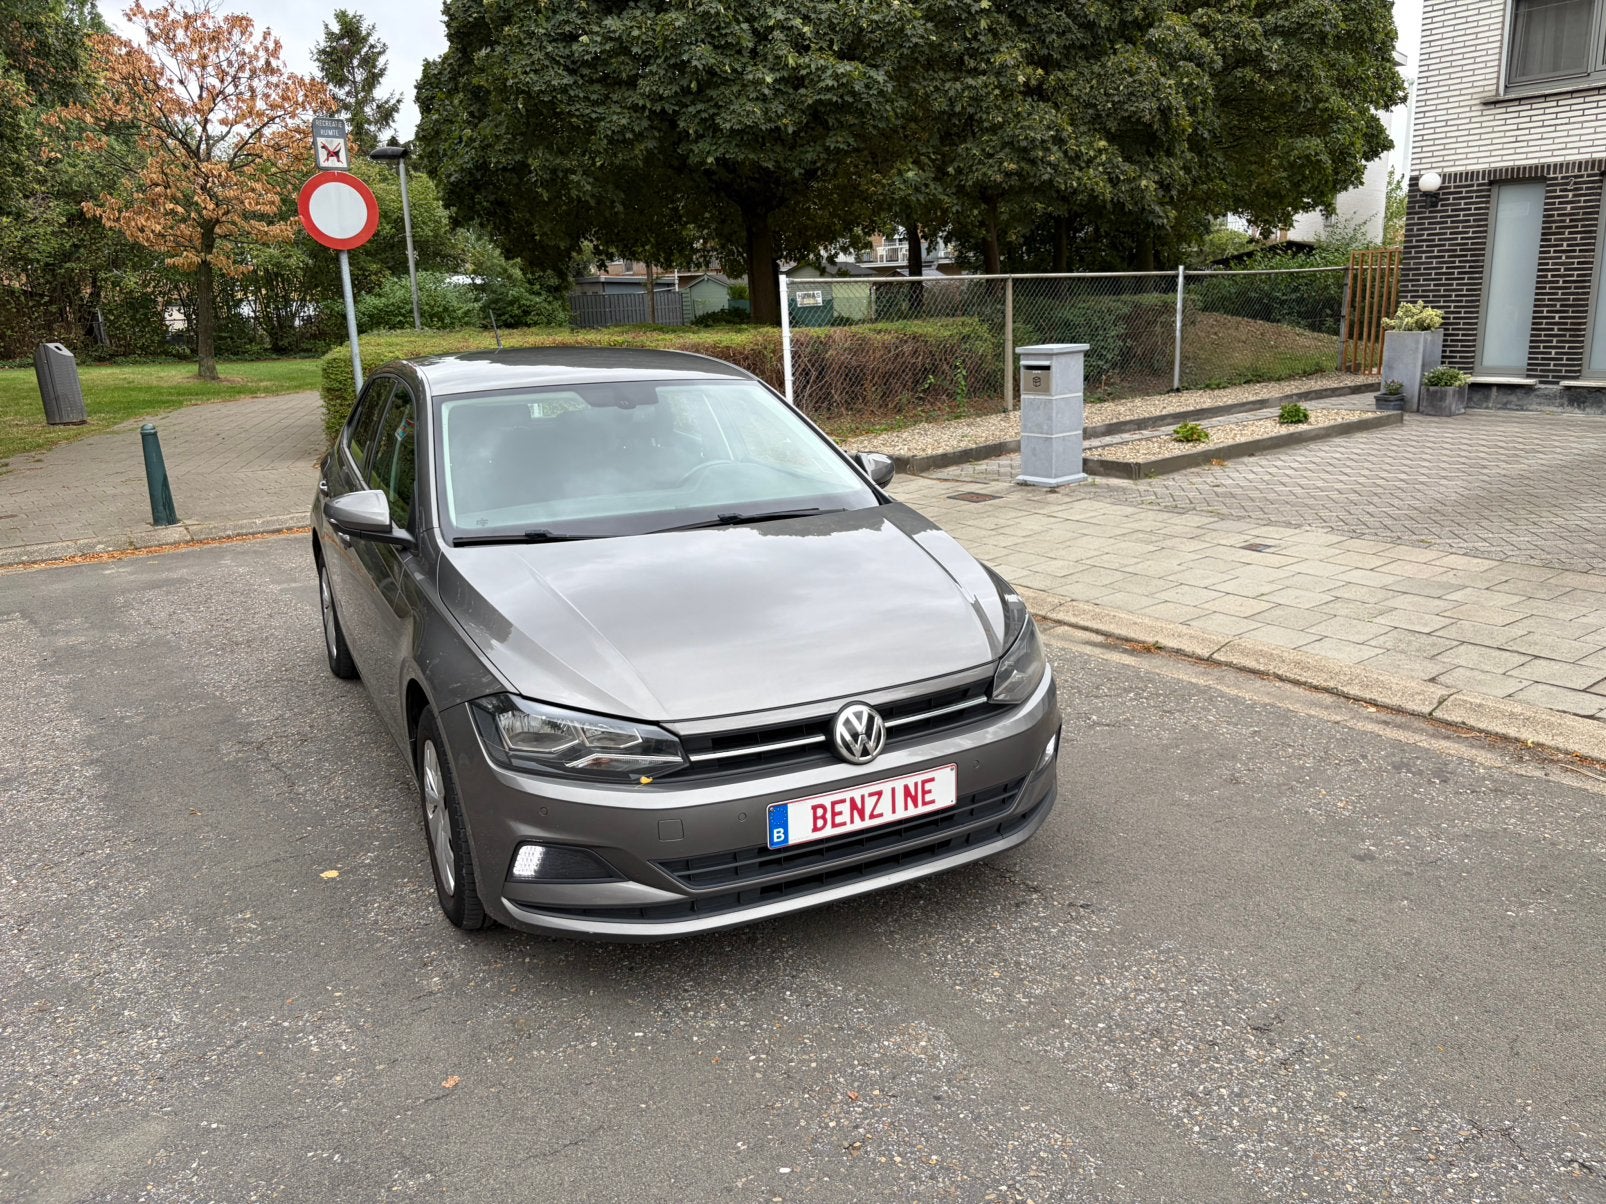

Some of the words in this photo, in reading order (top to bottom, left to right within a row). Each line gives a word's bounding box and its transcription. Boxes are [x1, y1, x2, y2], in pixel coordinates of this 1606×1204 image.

[315, 120, 343, 128] RECREATIE
[321, 129, 340, 137] RUIMTE
[837, 704, 886, 763] VW
[773, 828, 785, 842] B
[811, 777, 935, 833] BENZINE
